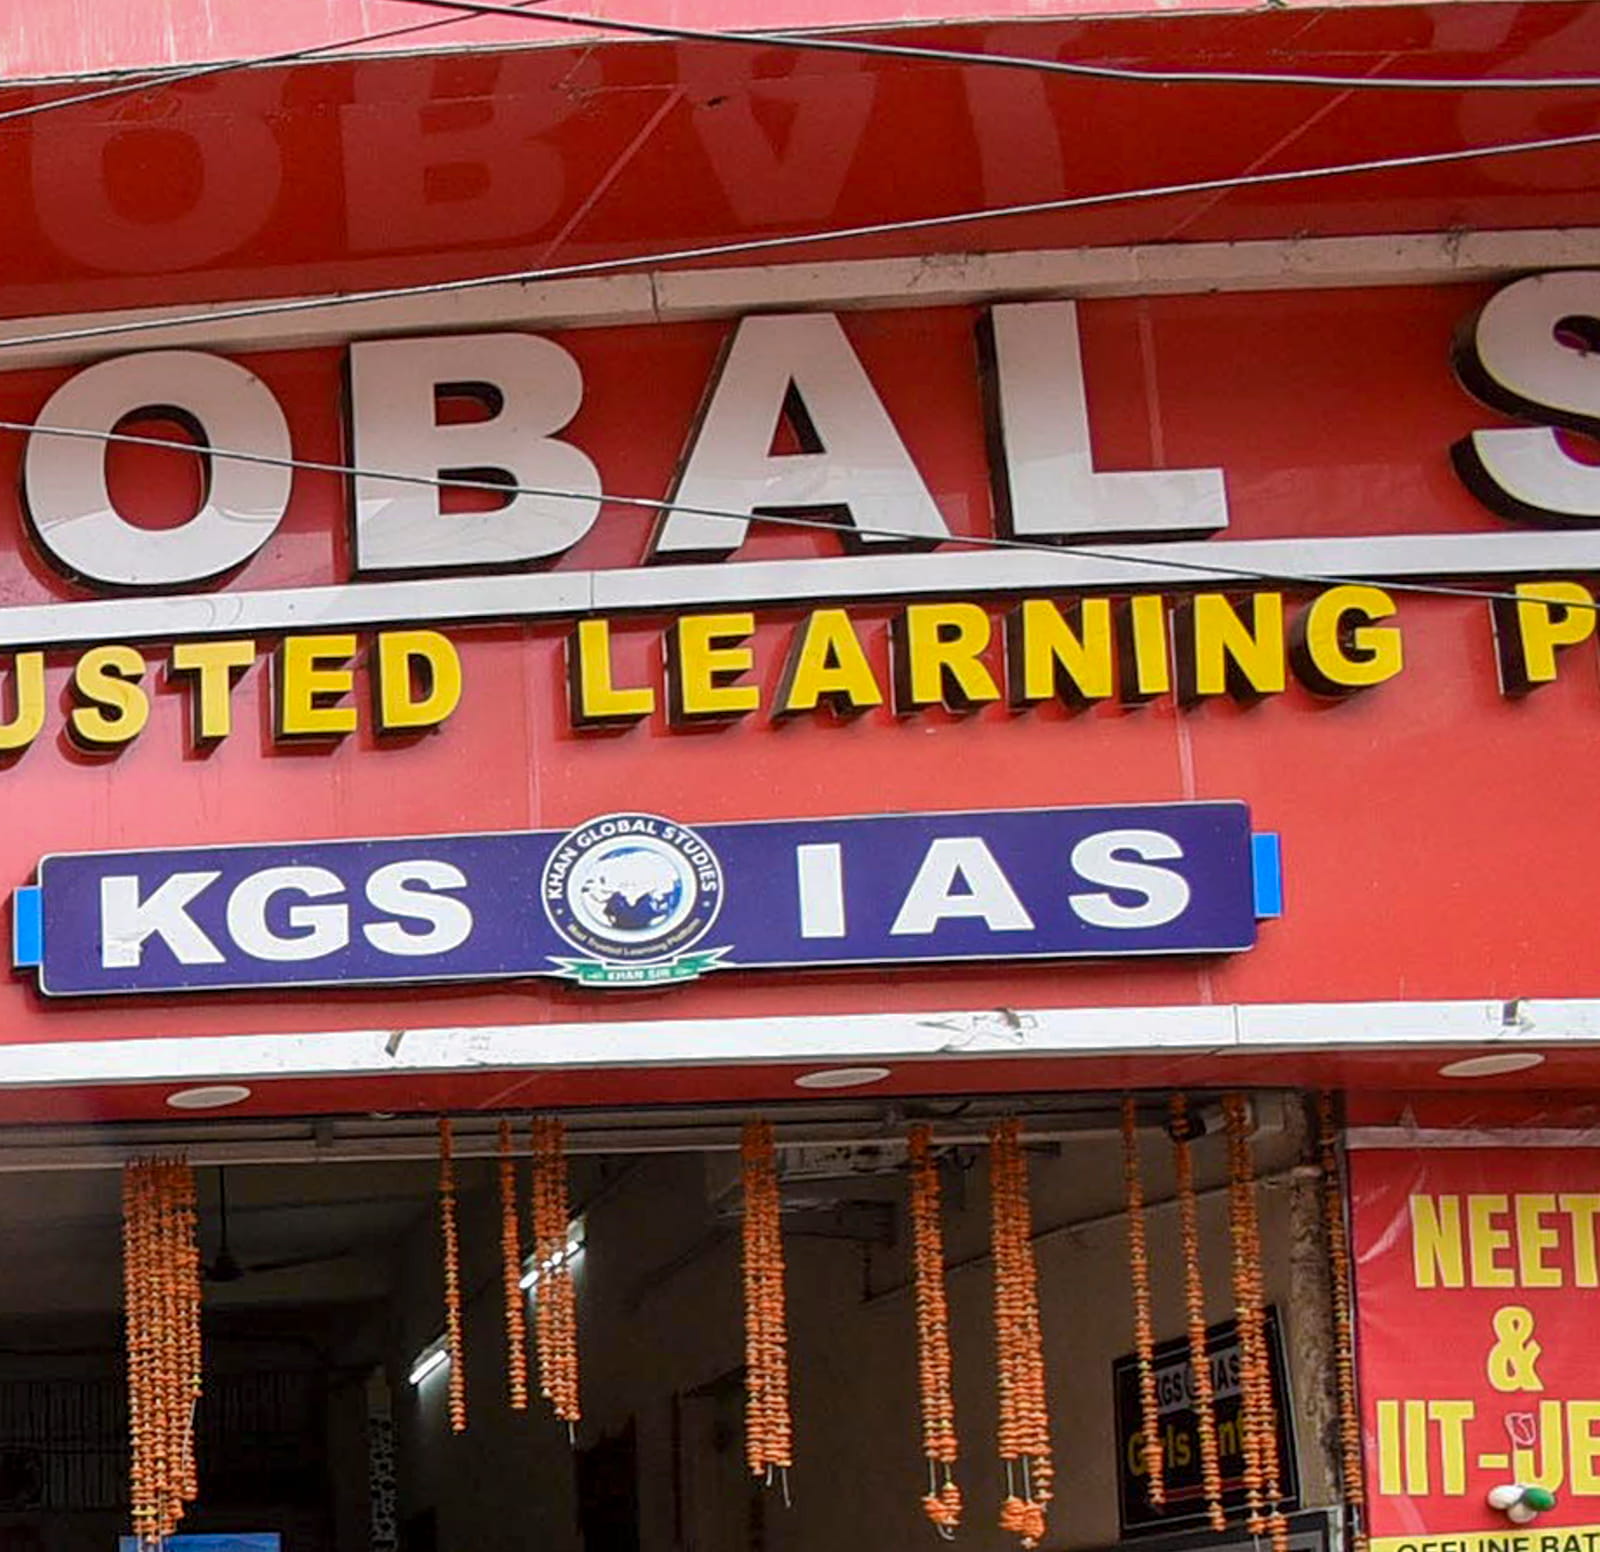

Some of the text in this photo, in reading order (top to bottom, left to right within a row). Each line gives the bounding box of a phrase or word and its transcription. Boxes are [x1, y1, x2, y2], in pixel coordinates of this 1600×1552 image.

[576, 584, 1404, 720] LEARNING
[99, 828, 1194, 971] KGS IAS
[548, 818, 717, 899] KHAN GLOBAL STUDIES
[1410, 1193, 1600, 1290] NEET
[1487, 1305, 1544, 1392] &
